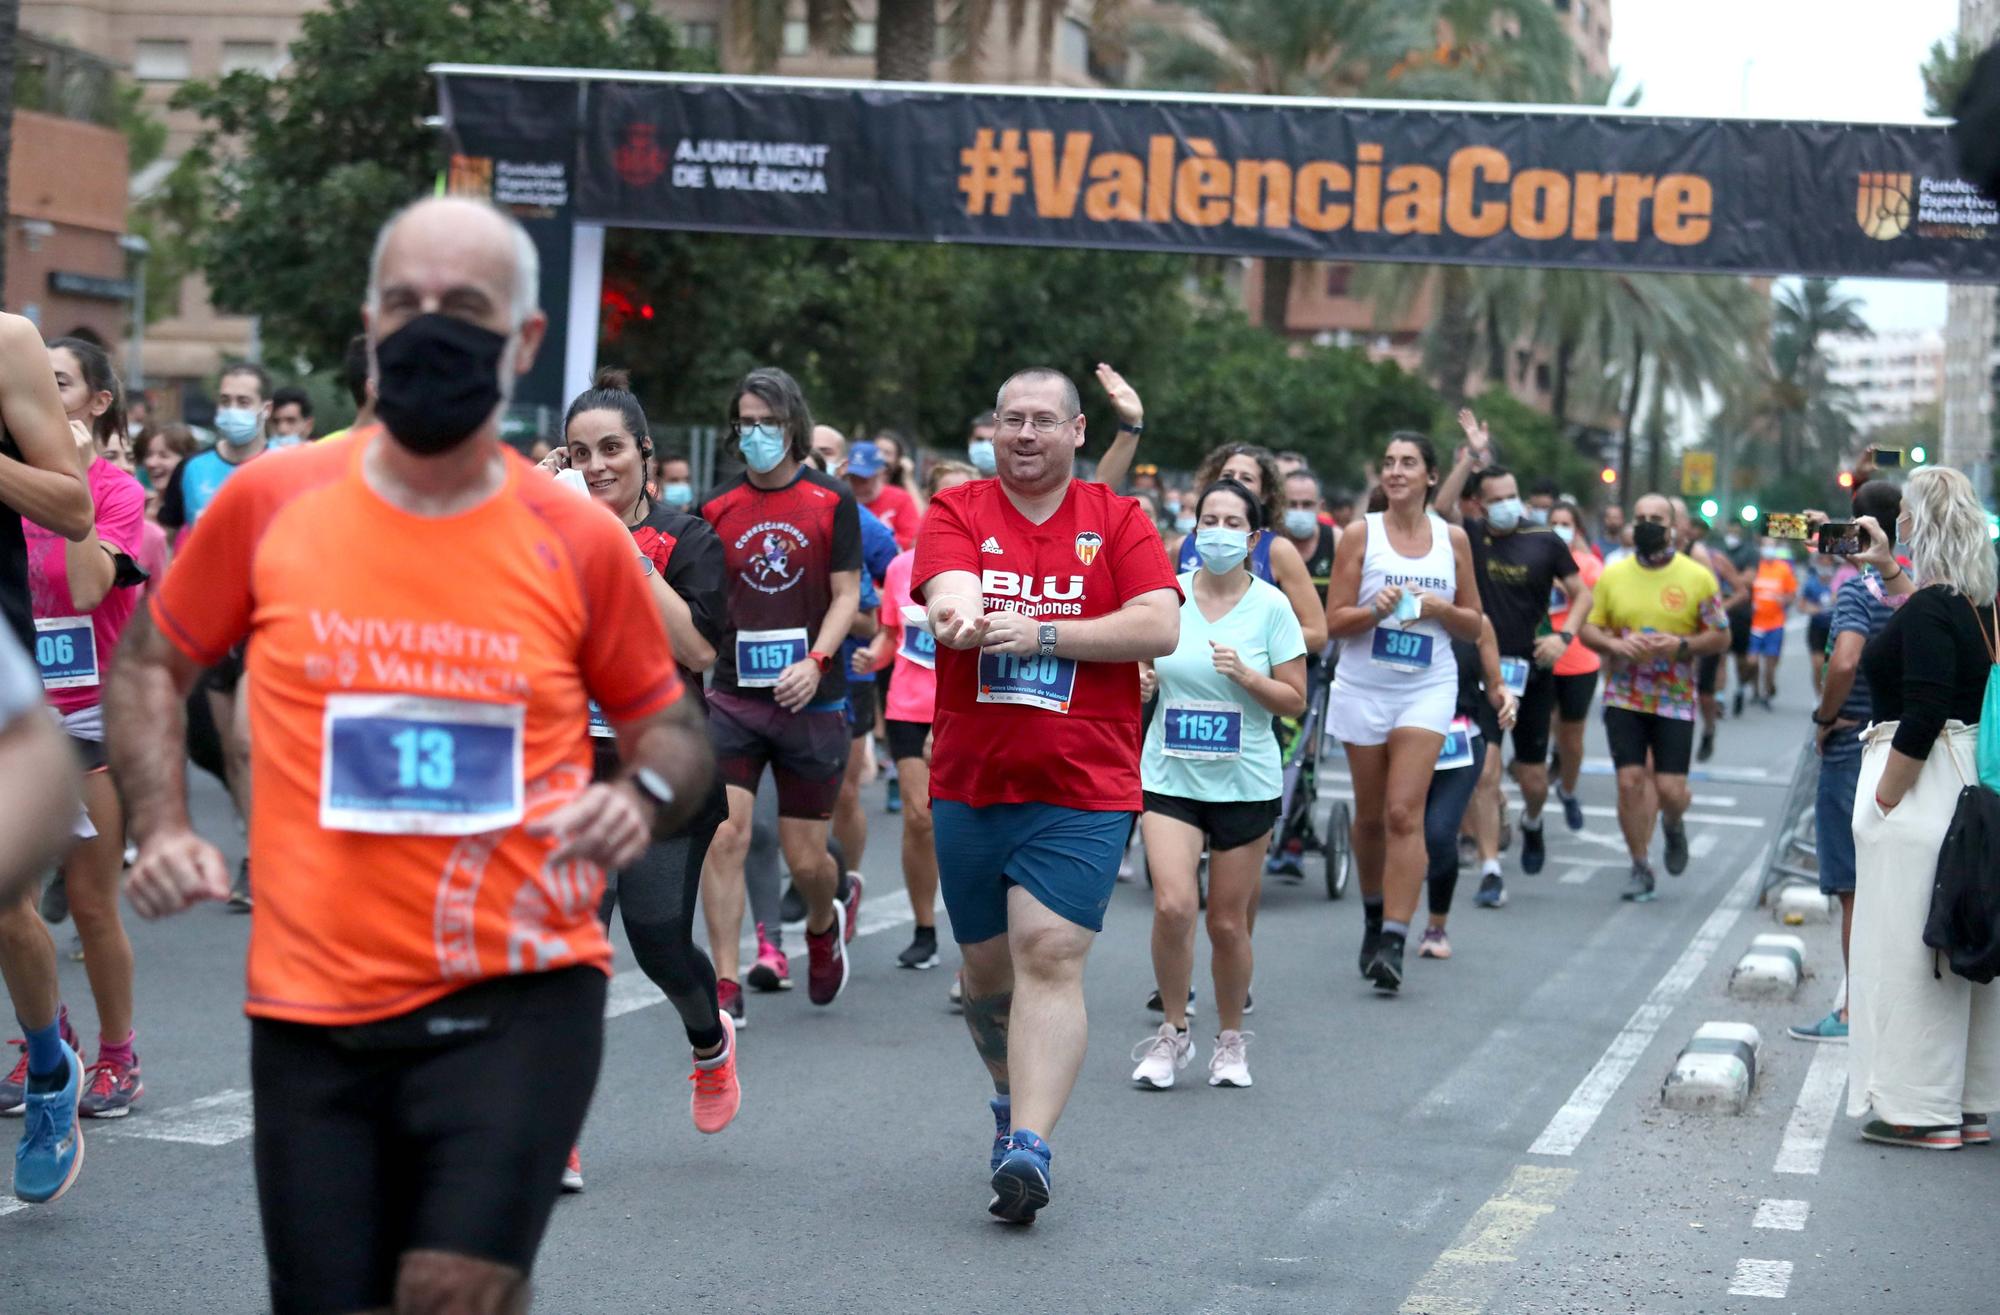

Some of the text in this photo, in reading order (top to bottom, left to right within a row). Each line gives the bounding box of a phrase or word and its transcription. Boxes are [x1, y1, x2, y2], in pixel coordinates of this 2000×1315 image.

[675, 138, 830, 168] AJUNTAMENT
[672, 163, 706, 188] DE
[958, 128, 1713, 245] #ValènciaCorre
[1918, 208, 1999, 228] Municipal
[981, 546, 1004, 555] adidas
[983, 569, 1084, 603] BLU
[983, 596, 1082, 617] smartphones
[36, 634, 74, 666] 06
[748, 644, 794, 669] 1157
[1386, 632, 1422, 657] 397
[995, 653, 1058, 685] 1130
[1177, 714, 1228, 742] 1152
[391, 728, 454, 789] 13
